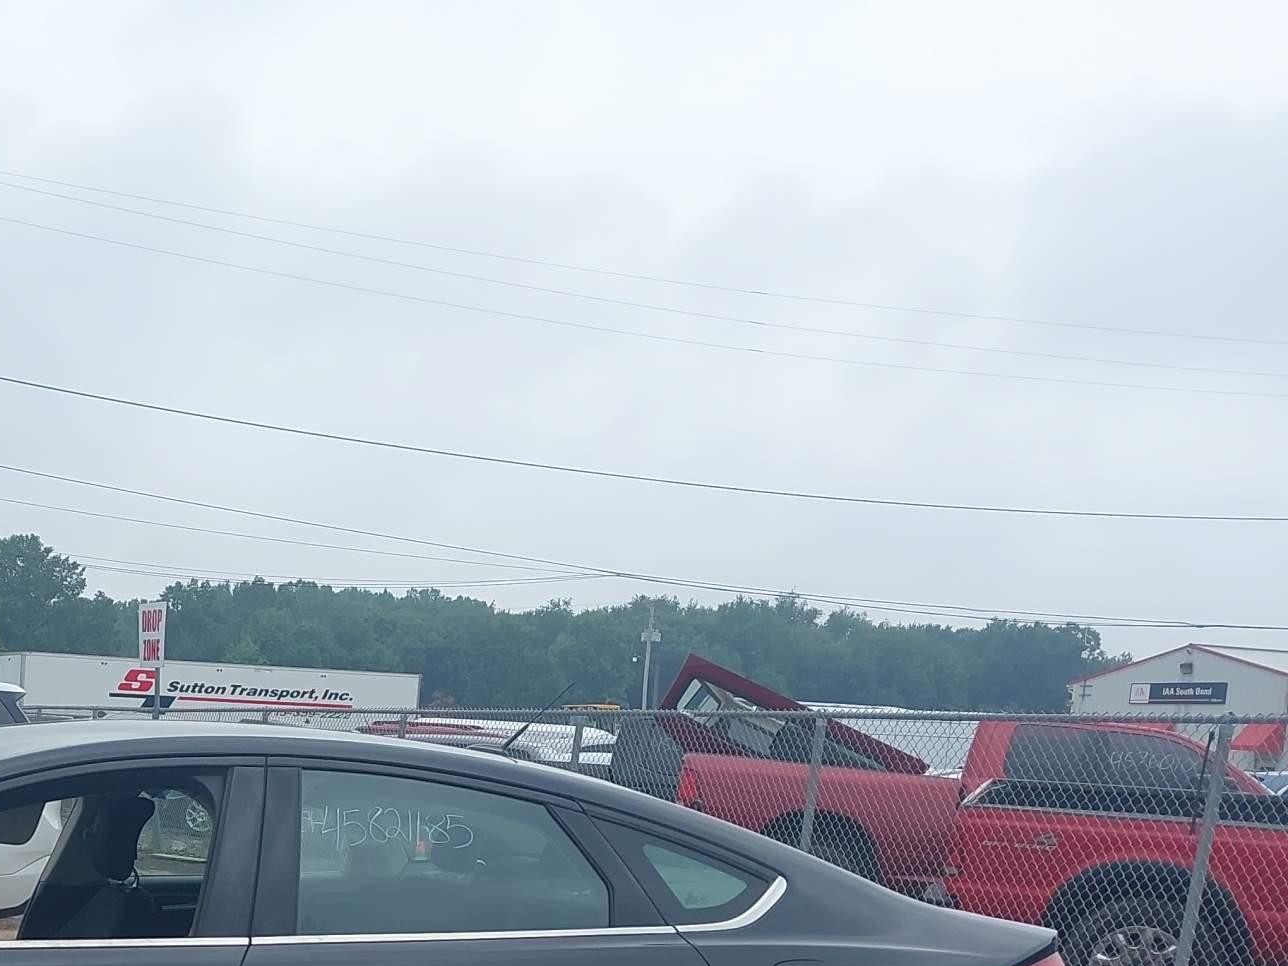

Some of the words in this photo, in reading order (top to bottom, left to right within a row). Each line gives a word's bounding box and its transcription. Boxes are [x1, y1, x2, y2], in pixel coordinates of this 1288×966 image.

[142, 608, 163, 632] DROP
[143, 639, 161, 661] ZONE
[167, 680, 230, 696] Sutton
[230, 683, 319, 702] Transport,
[322, 688, 354, 702] Inc.
